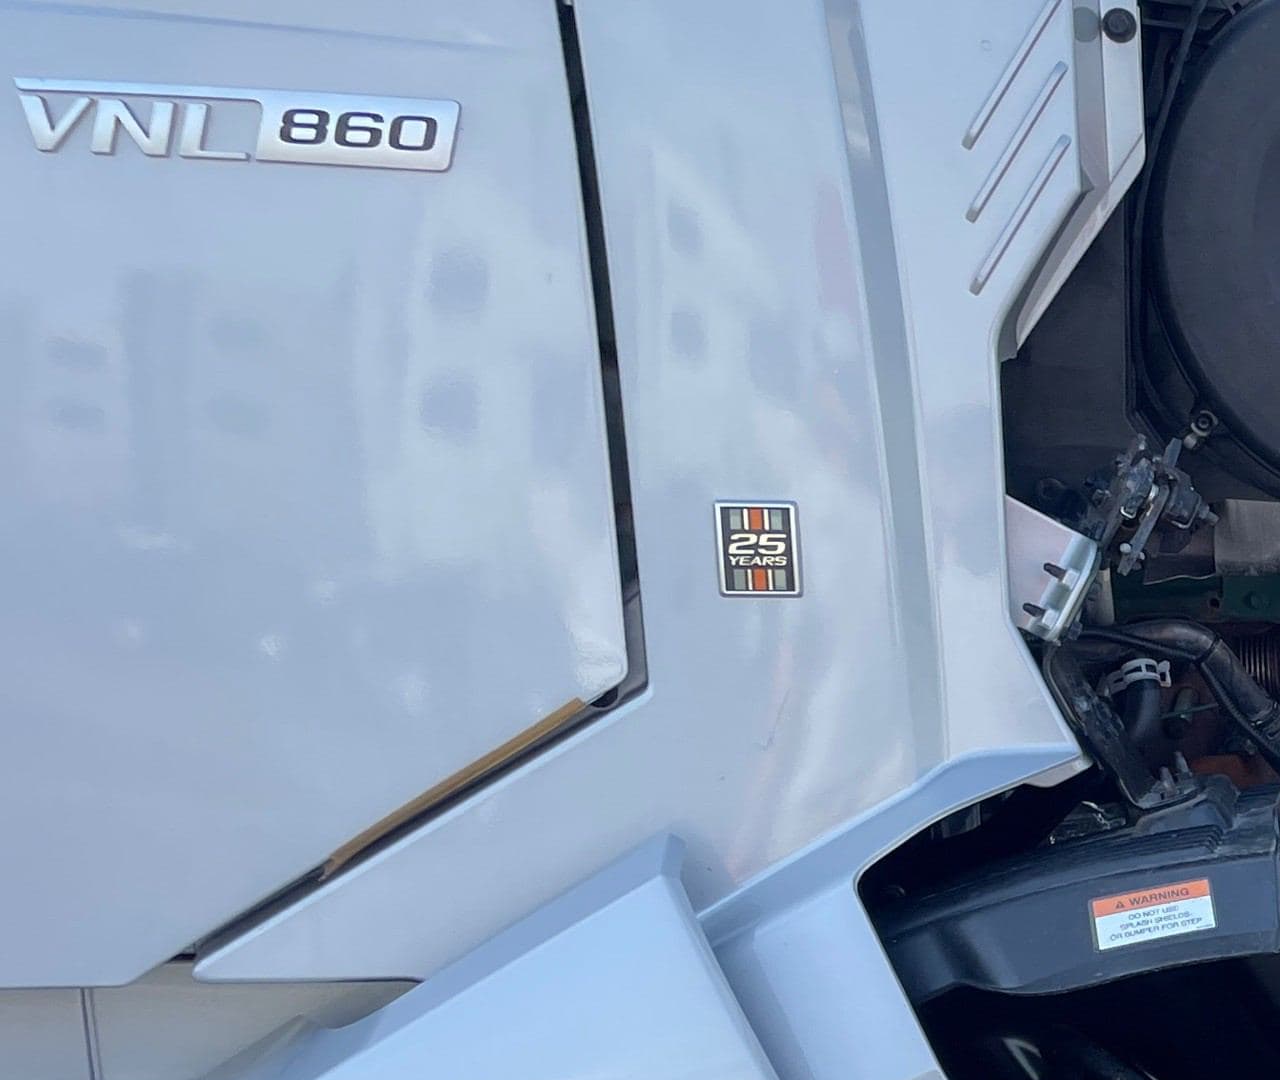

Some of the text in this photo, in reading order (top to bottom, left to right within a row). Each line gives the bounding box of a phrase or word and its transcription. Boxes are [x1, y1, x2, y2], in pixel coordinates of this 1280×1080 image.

[18, 93, 438, 162] VNL 860
[728, 533, 787, 555] 25
[728, 555, 788, 567] YEARS
[1128, 887, 1190, 907] WARNING
[1142, 908, 1161, 918] NOT
[1120, 919, 1153, 931] SPLASH
[1161, 921, 1179, 931] FOR
